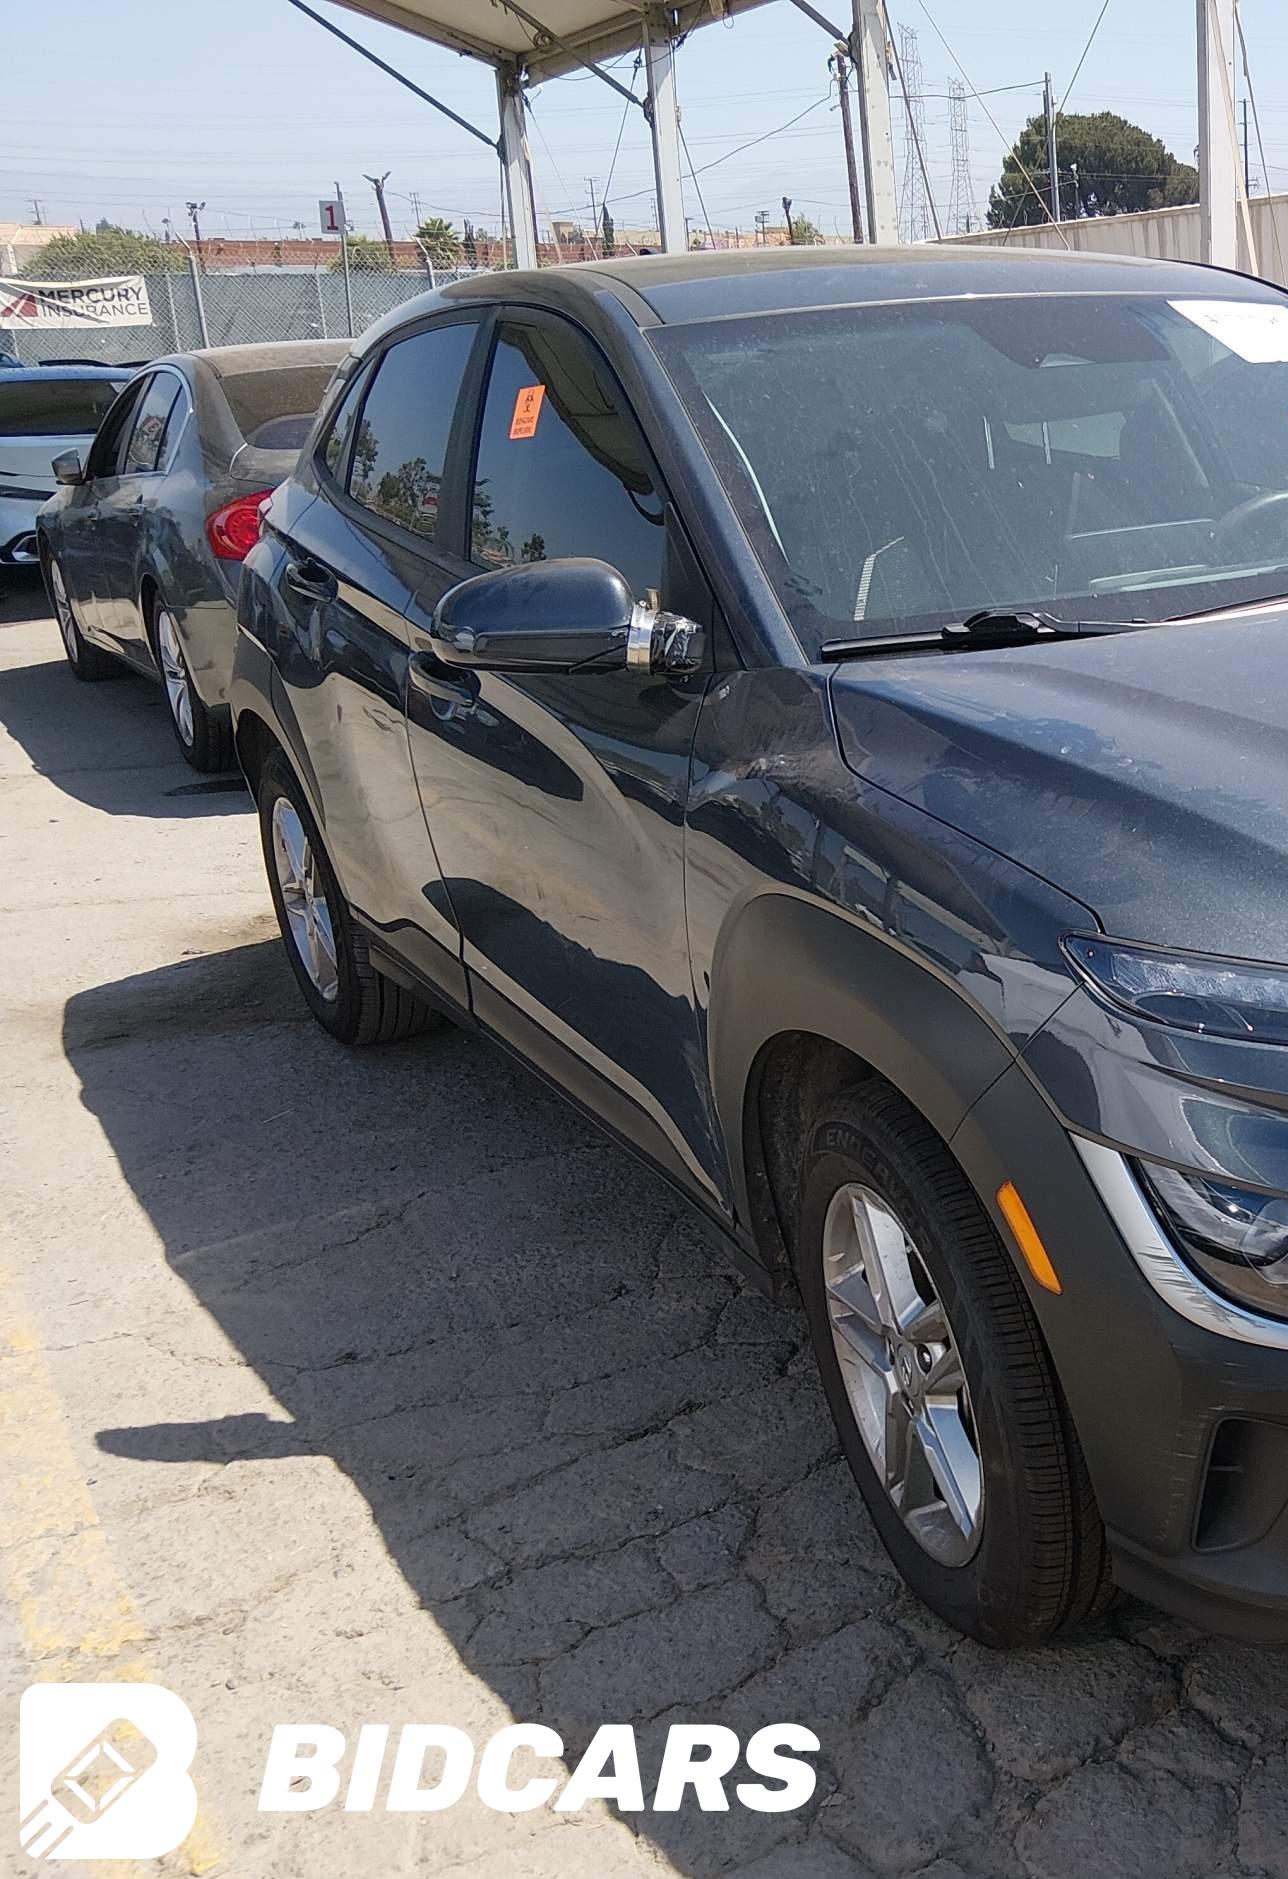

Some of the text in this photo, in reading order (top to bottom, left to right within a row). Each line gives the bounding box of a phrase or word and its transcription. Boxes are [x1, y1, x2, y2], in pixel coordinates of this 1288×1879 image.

[325, 204, 339, 230] 1
[38, 287, 142, 304] MERCURY
[41, 303, 149, 318] INSURANCE
